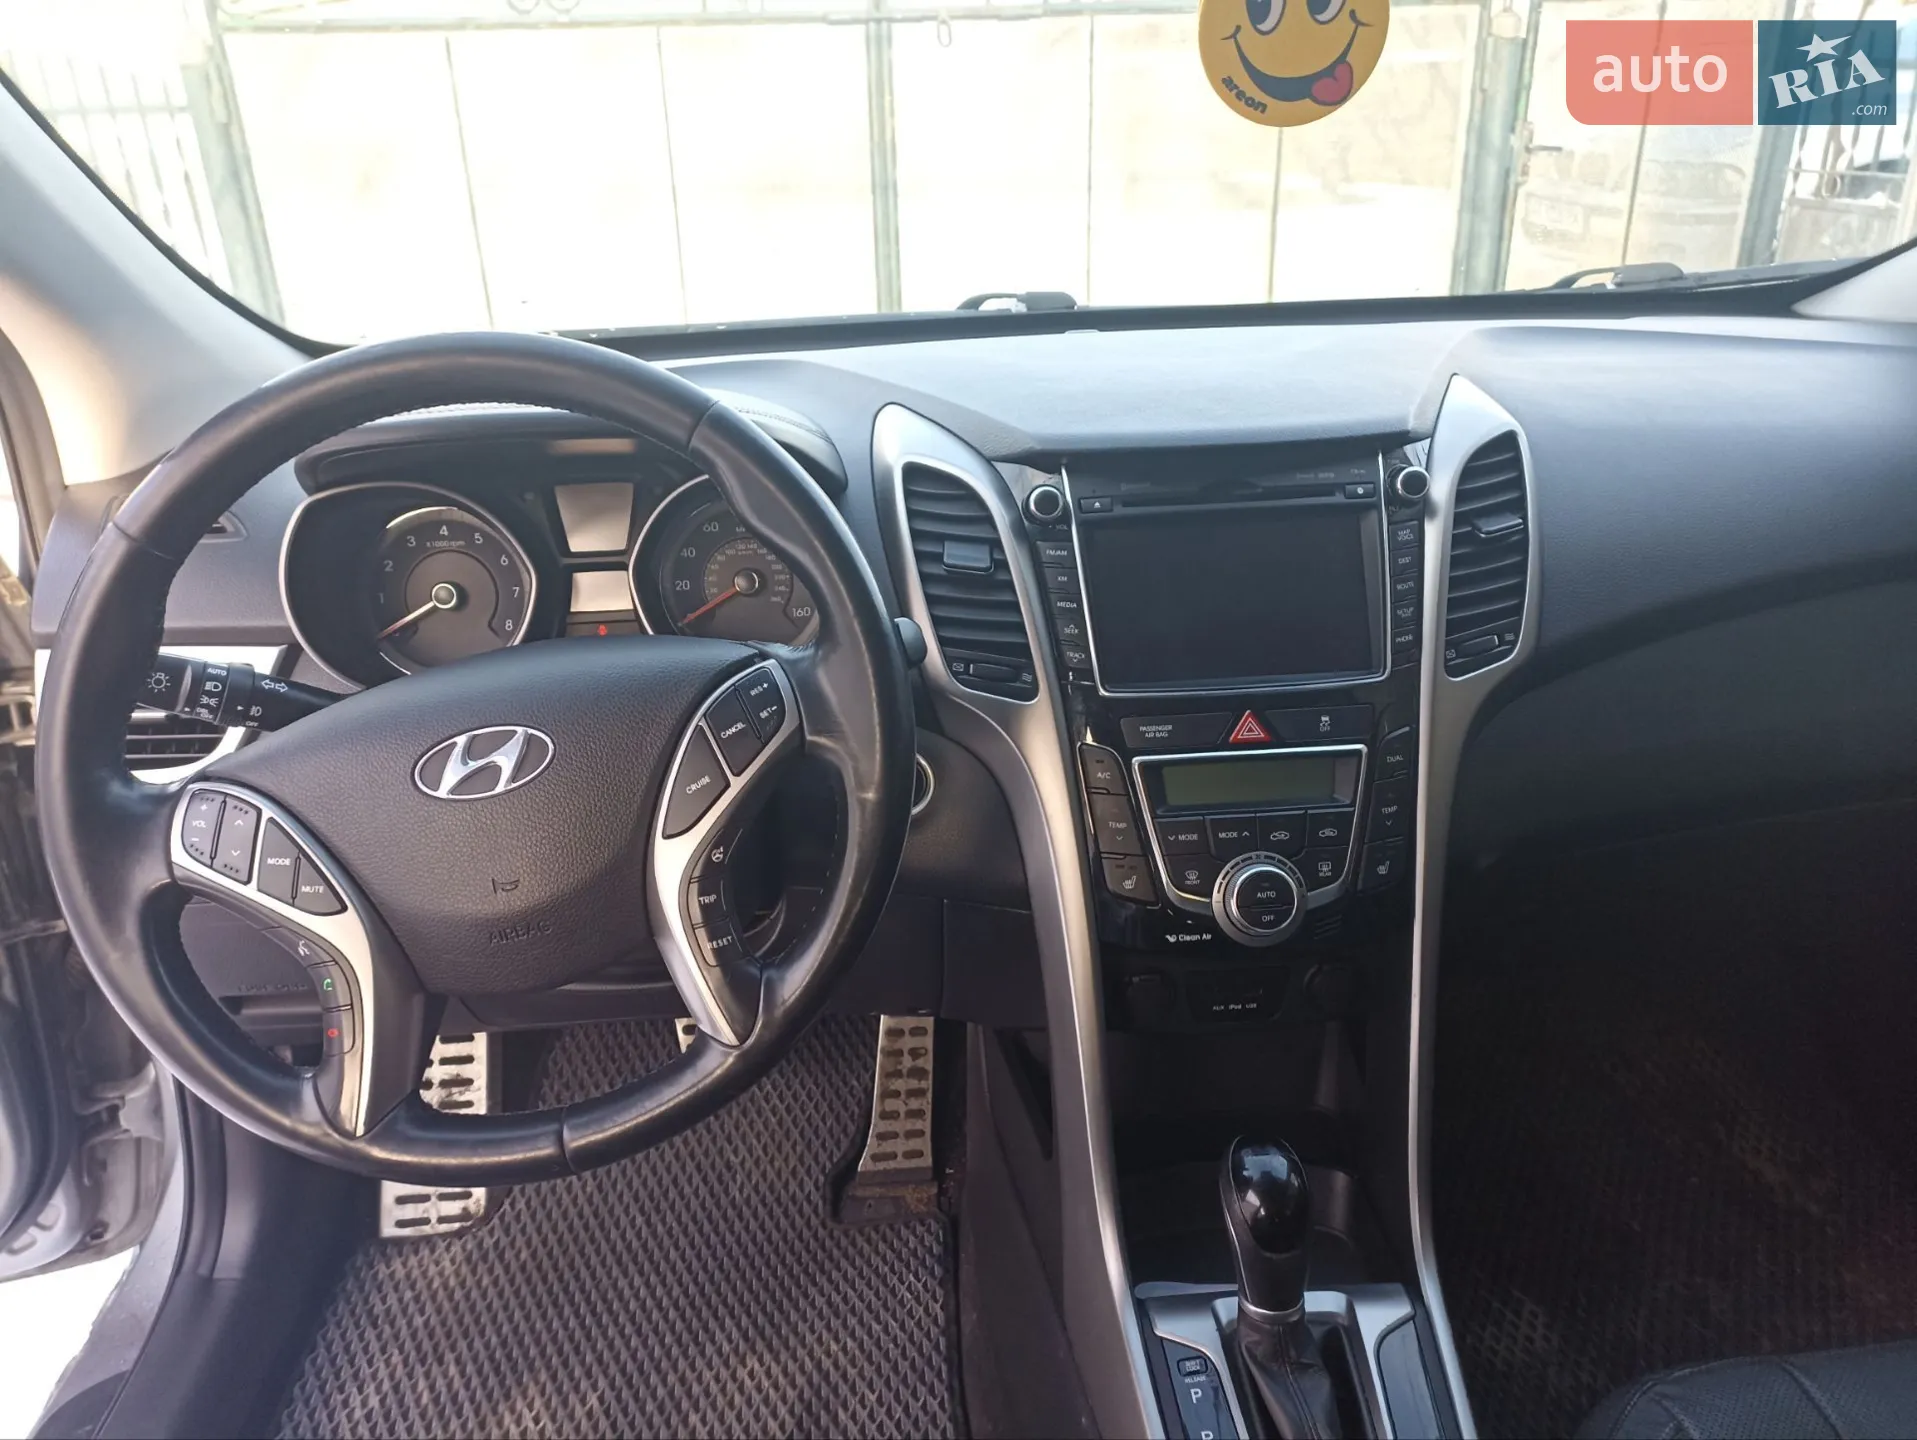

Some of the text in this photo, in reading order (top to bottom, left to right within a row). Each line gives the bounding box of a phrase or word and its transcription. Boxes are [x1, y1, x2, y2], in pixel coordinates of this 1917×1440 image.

[1221, 75, 1268, 114] areon
[439, 525, 449, 536] 4
[702, 521, 719, 532] 60
[406, 535, 416, 547] 3
[474, 532, 483, 544] 5
[680, 547, 696, 558] 40
[500, 554, 509, 566] 6
[383, 560, 394, 572] 2
[675, 579, 690, 591] 20
[512, 586, 520, 598] 7
[1056, 601, 1077, 609] MEDIA
[792, 606, 812, 617] 160
[505, 619, 513, 631] 8
[207, 667, 227, 677] AUTO
[720, 721, 747, 739] CANCEL
[1139, 724, 1173, 732] PASSENGER
[1386, 754, 1404, 763] DUAL
[1096, 771, 1111, 779] A/C
[685, 774, 711, 795] CRUISE
[1382, 805, 1398, 814] TEMP
[192, 820, 207, 829] VOL
[1108, 821, 1127, 829] TEMP
[1178, 833, 1199, 841] MODE
[1218, 831, 1238, 839] MODE
[266, 857, 291, 866] MODE
[301, 885, 325, 894] MUTE
[1256, 890, 1276, 898] AUTO
[698, 894, 717, 905] TRIP
[489, 920, 552, 946] AIRBAG
[1178, 933, 1201, 942] Clean
[706, 935, 733, 950] RESET
[1190, 1388, 1203, 1404] P
